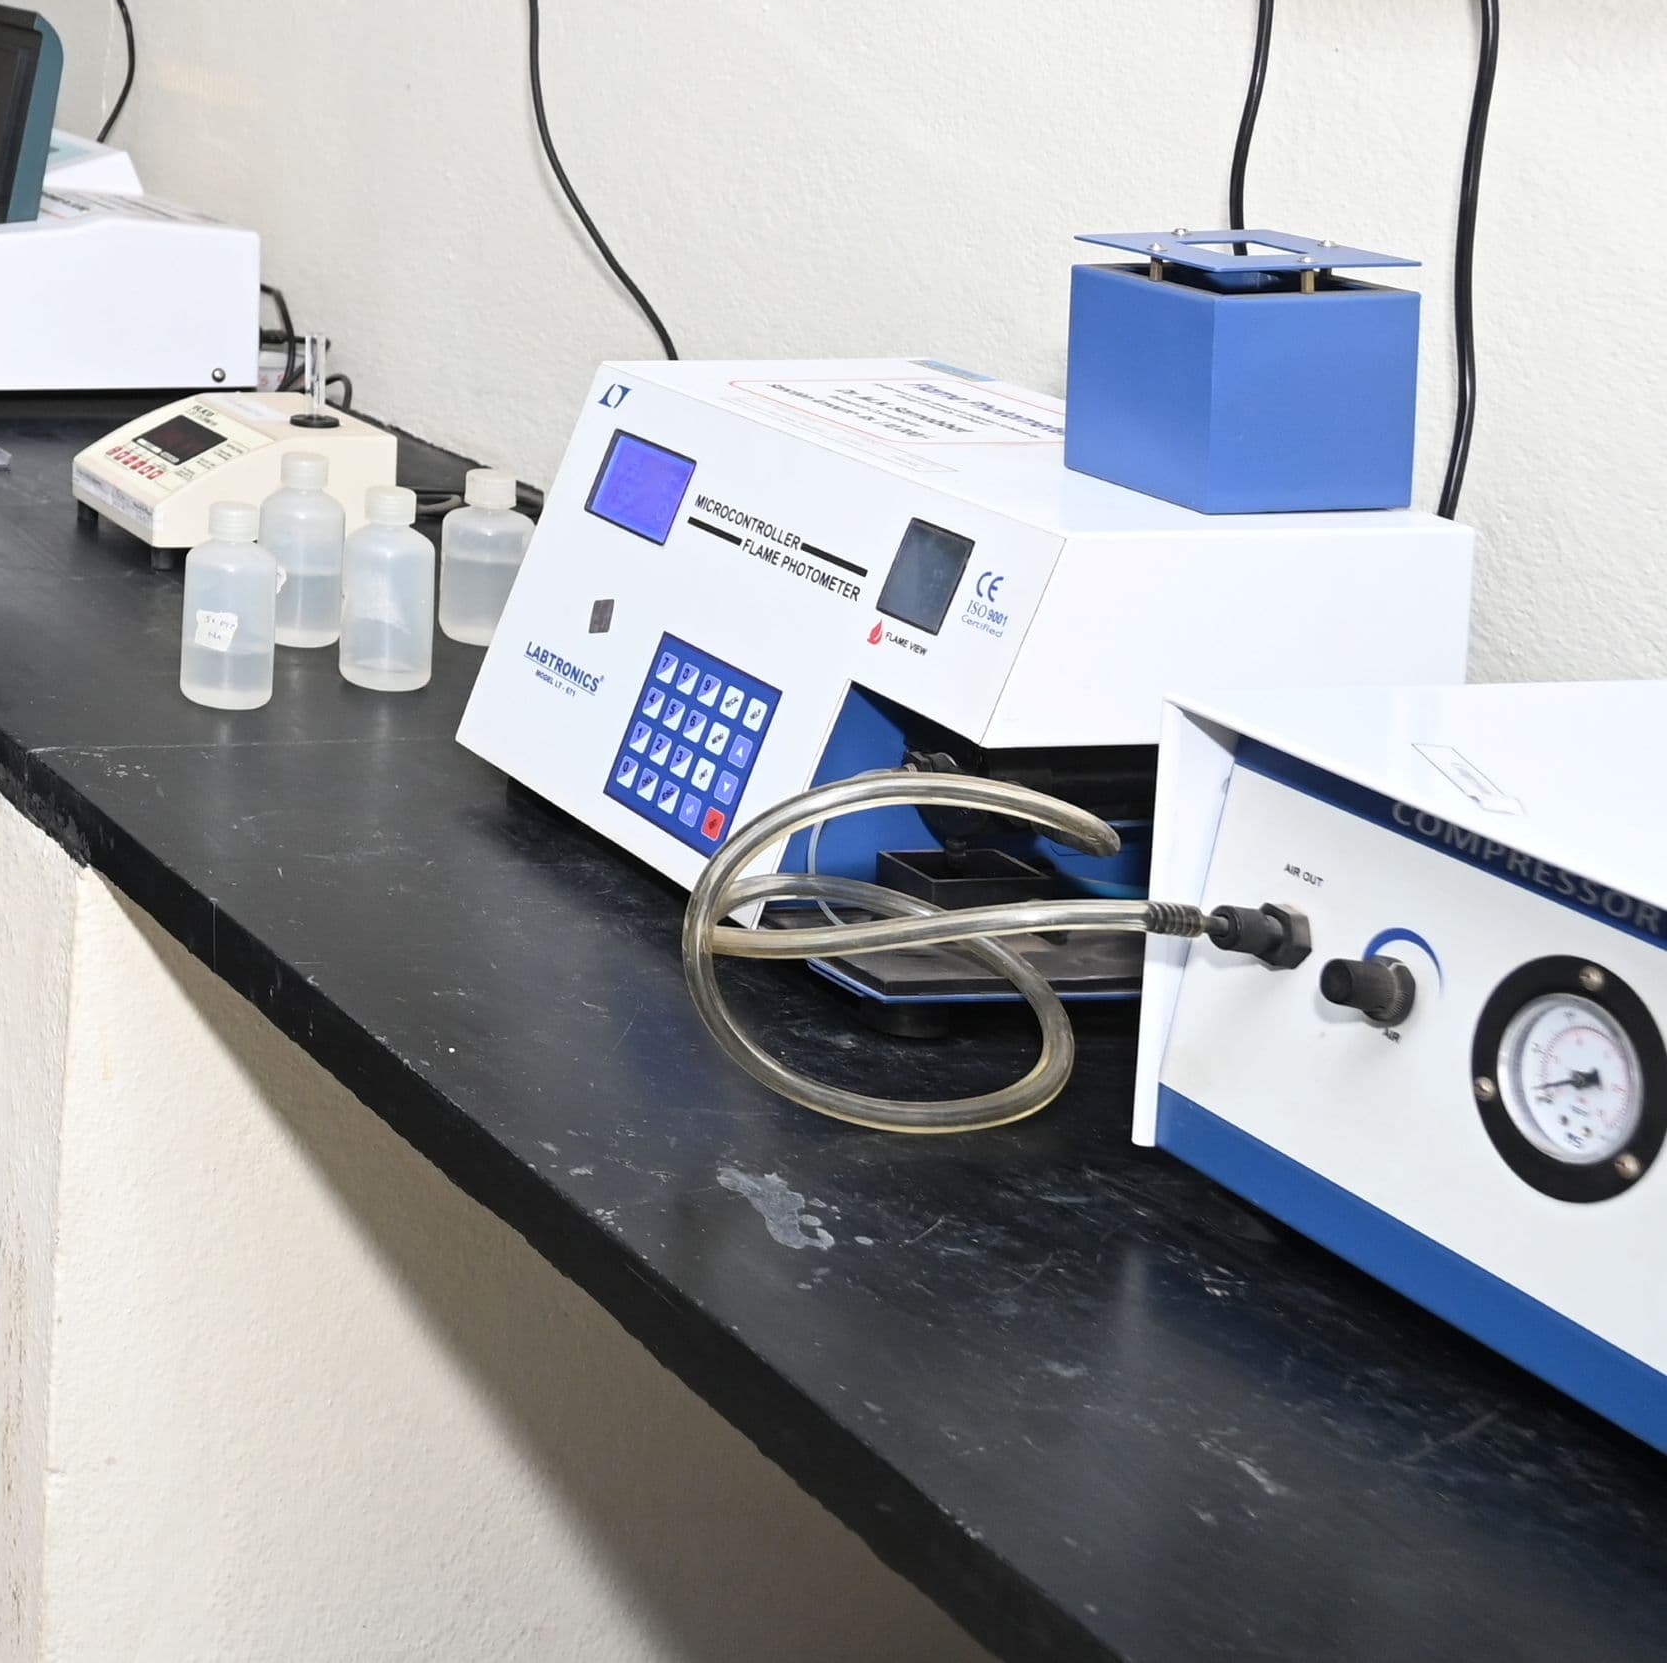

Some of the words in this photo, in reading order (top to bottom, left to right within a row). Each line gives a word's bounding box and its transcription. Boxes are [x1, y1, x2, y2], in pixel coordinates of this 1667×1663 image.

[694, 494, 801, 550] MICROCONTROLLER
[742, 538, 781, 566] FLAME
[780, 555, 861, 602] PHOTOMETER
[976, 571, 1004, 602] CE
[961, 614, 1003, 638] Certified
[966, 600, 987, 618] ISO
[987, 609, 1008, 627] 9001
[885, 631, 909, 649] FLAME
[909, 641, 927, 656] VIEW
[526, 641, 600, 692] LABTRONICS
[661, 657, 669, 669] 7
[703, 679, 711, 691] 9
[649, 692, 656, 703] 4
[669, 703, 677, 714] 5
[689, 715, 697, 727] 6
[636, 727, 643, 738] 1
[655, 739, 663, 750] 2
[675, 751, 683, 762] 3
[622, 761, 630, 772] 0
[1284, 863, 1301, 878] AIR
[1302, 872, 1324, 886] OUT
[1392, 800, 1660, 935] COMPRESSOR
[1382, 1028, 1401, 1043] AIR
